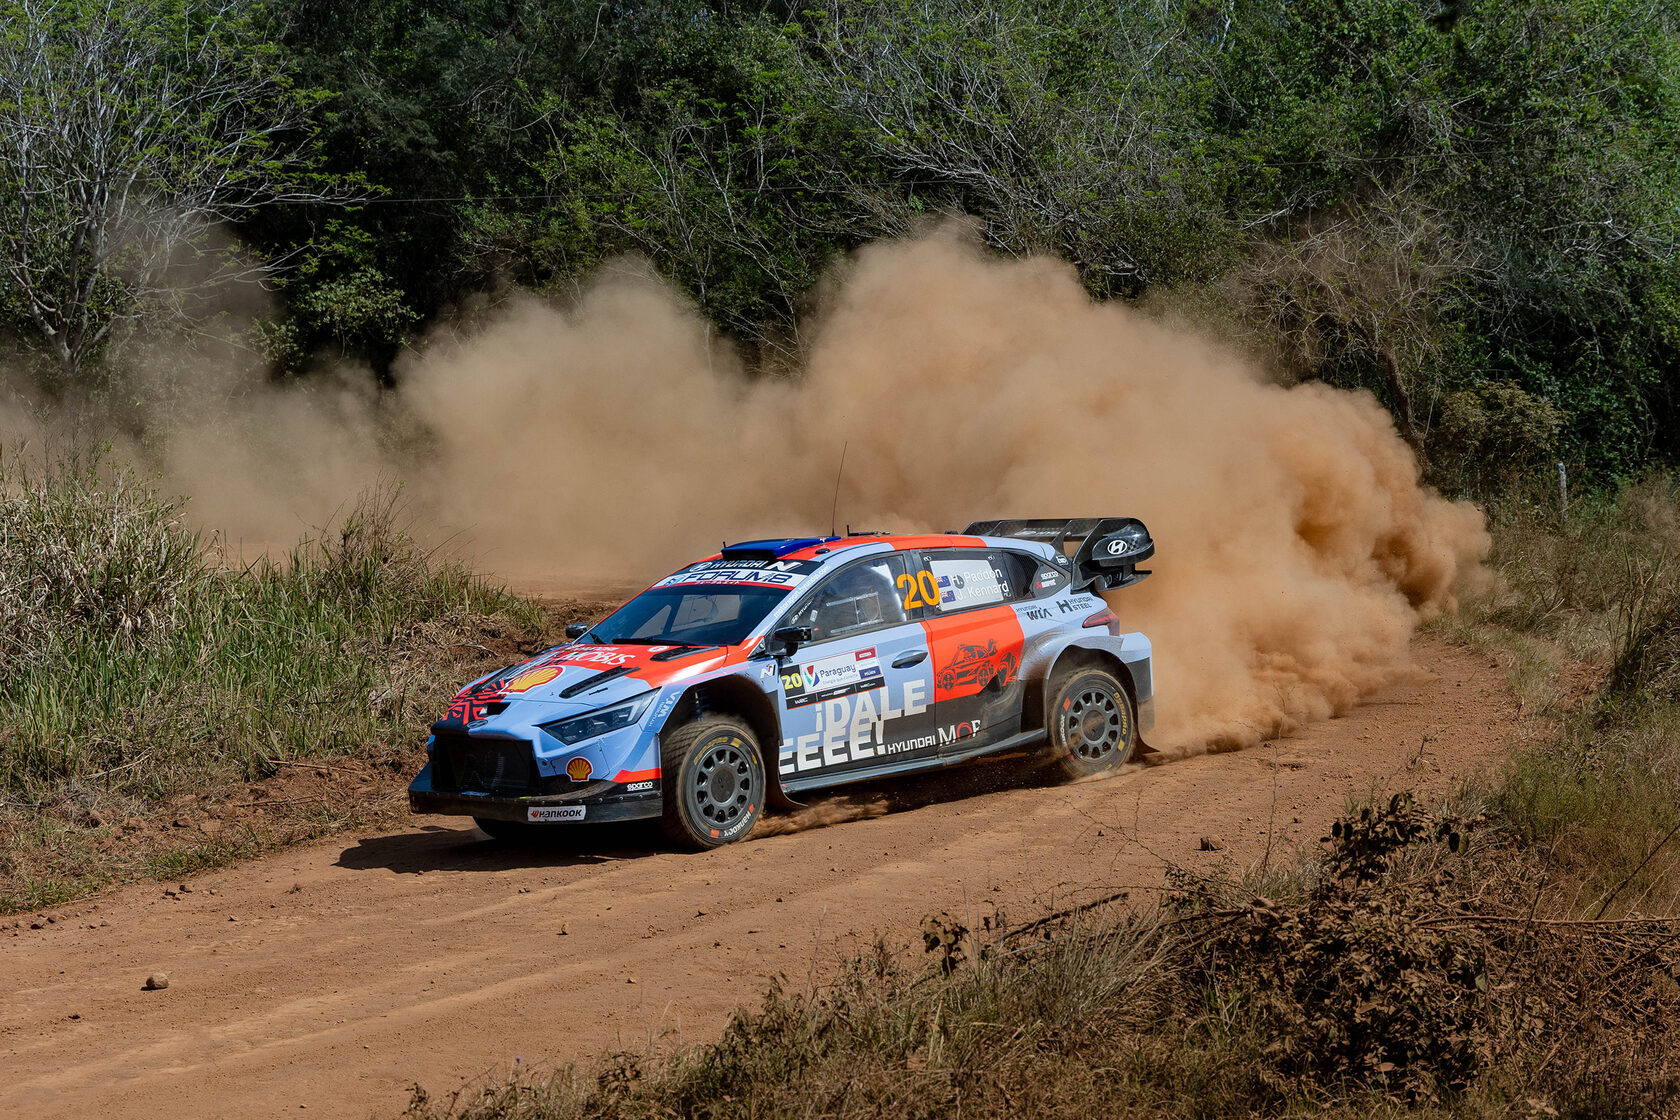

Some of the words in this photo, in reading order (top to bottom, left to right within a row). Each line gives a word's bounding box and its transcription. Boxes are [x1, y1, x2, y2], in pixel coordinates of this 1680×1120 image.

[710, 560, 769, 569] HYUNDAI
[682, 570, 793, 584] FORUM8
[963, 568, 1003, 585] Paddon
[896, 569, 941, 610] 20
[967, 580, 1010, 600] Kennard
[1072, 603, 1093, 612] STEEL
[555, 650, 636, 666] MOBIS
[819, 663, 857, 679] Paraguay
[780, 672, 802, 690] 20
[815, 678, 927, 738] ¡DALE
[887, 734, 937, 755] HYUNDAI
[626, 781, 653, 791] sparco
[539, 808, 583, 819] HANKOOK
